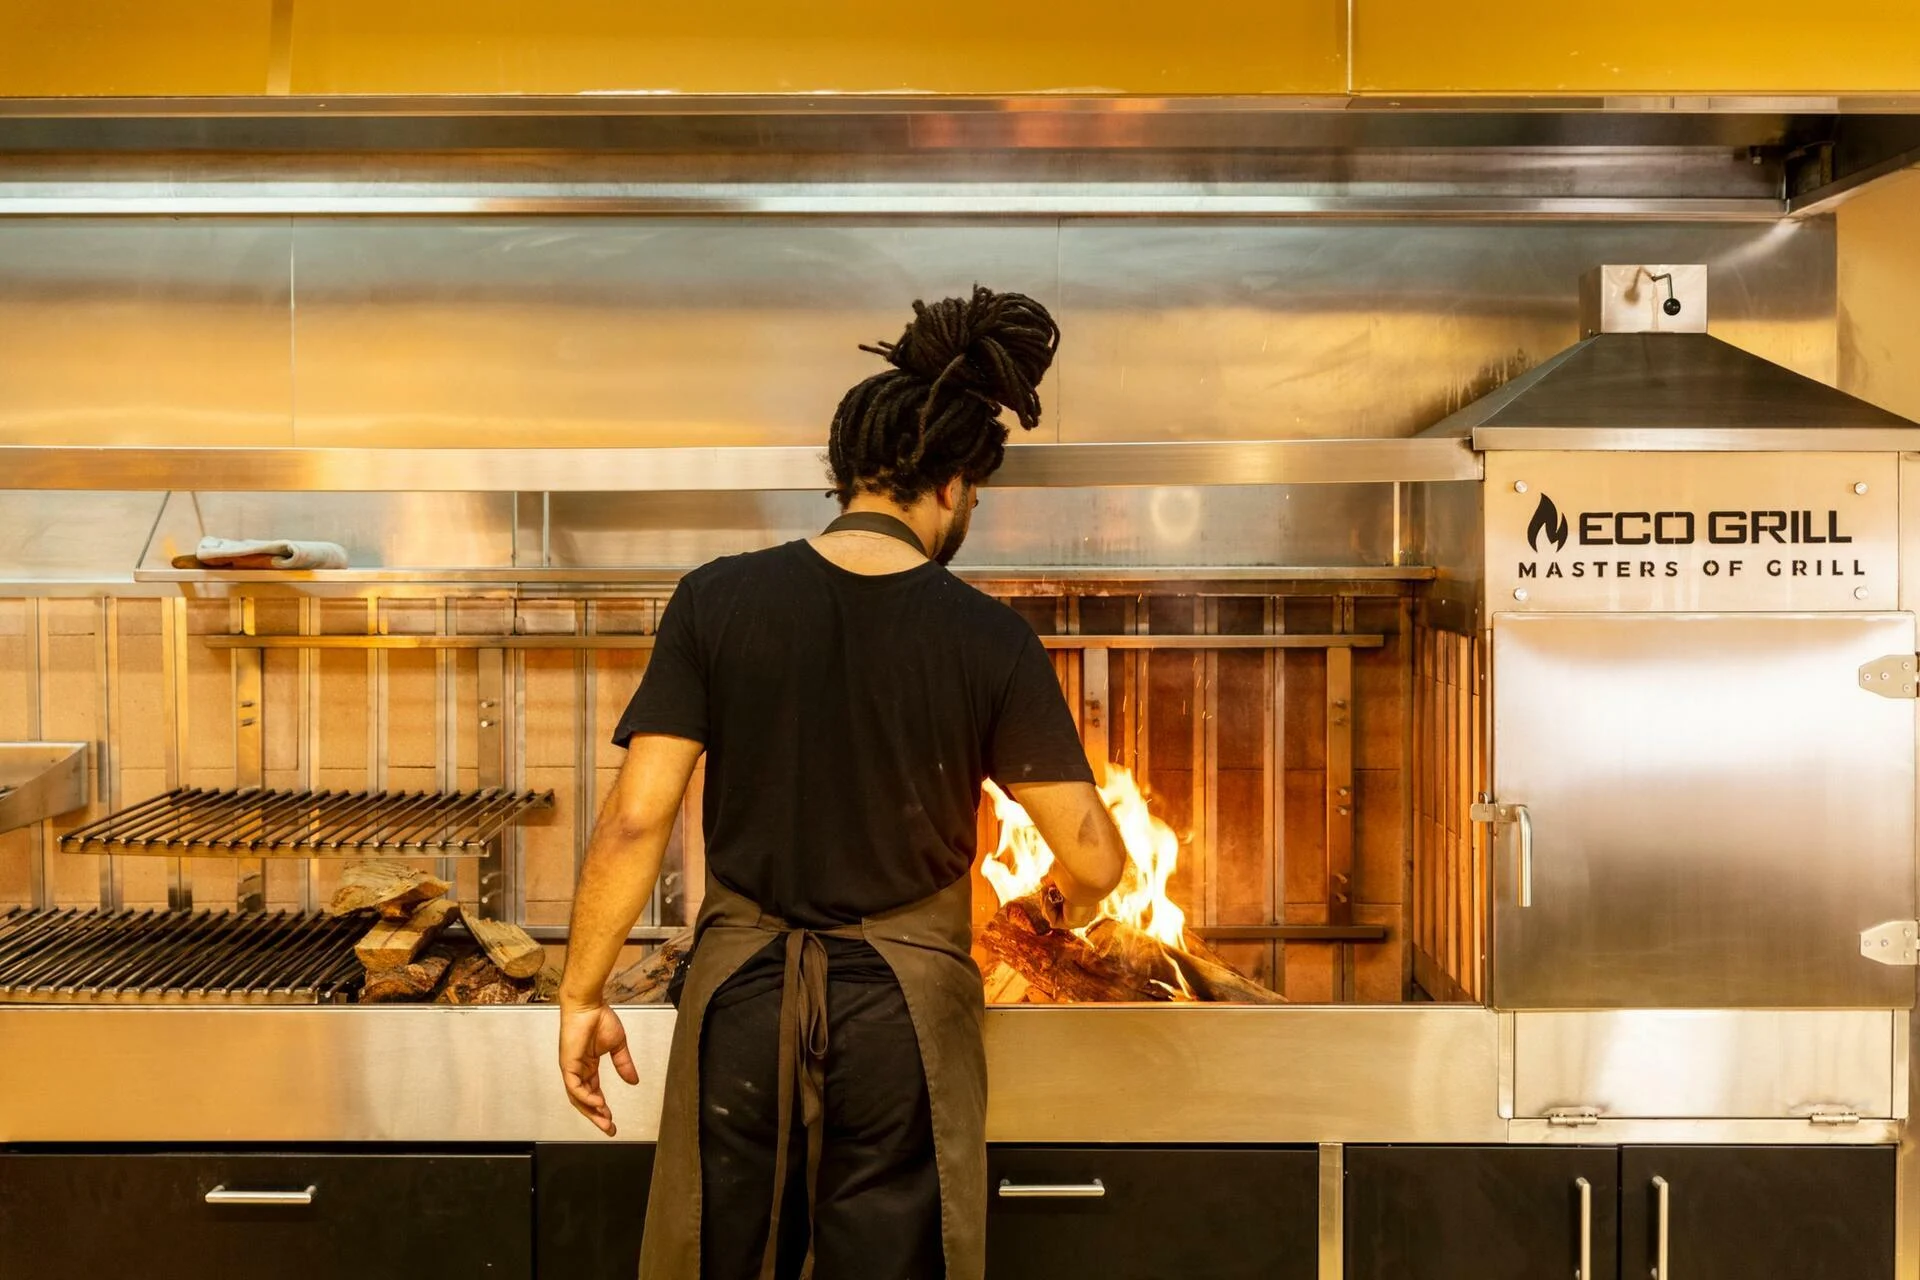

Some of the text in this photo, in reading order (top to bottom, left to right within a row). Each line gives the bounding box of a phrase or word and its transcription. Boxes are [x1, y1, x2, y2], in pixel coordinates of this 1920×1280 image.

[1579, 510, 1853, 546] ECO GRILL
[1518, 559, 1866, 579] MASTERS OF GRILL
